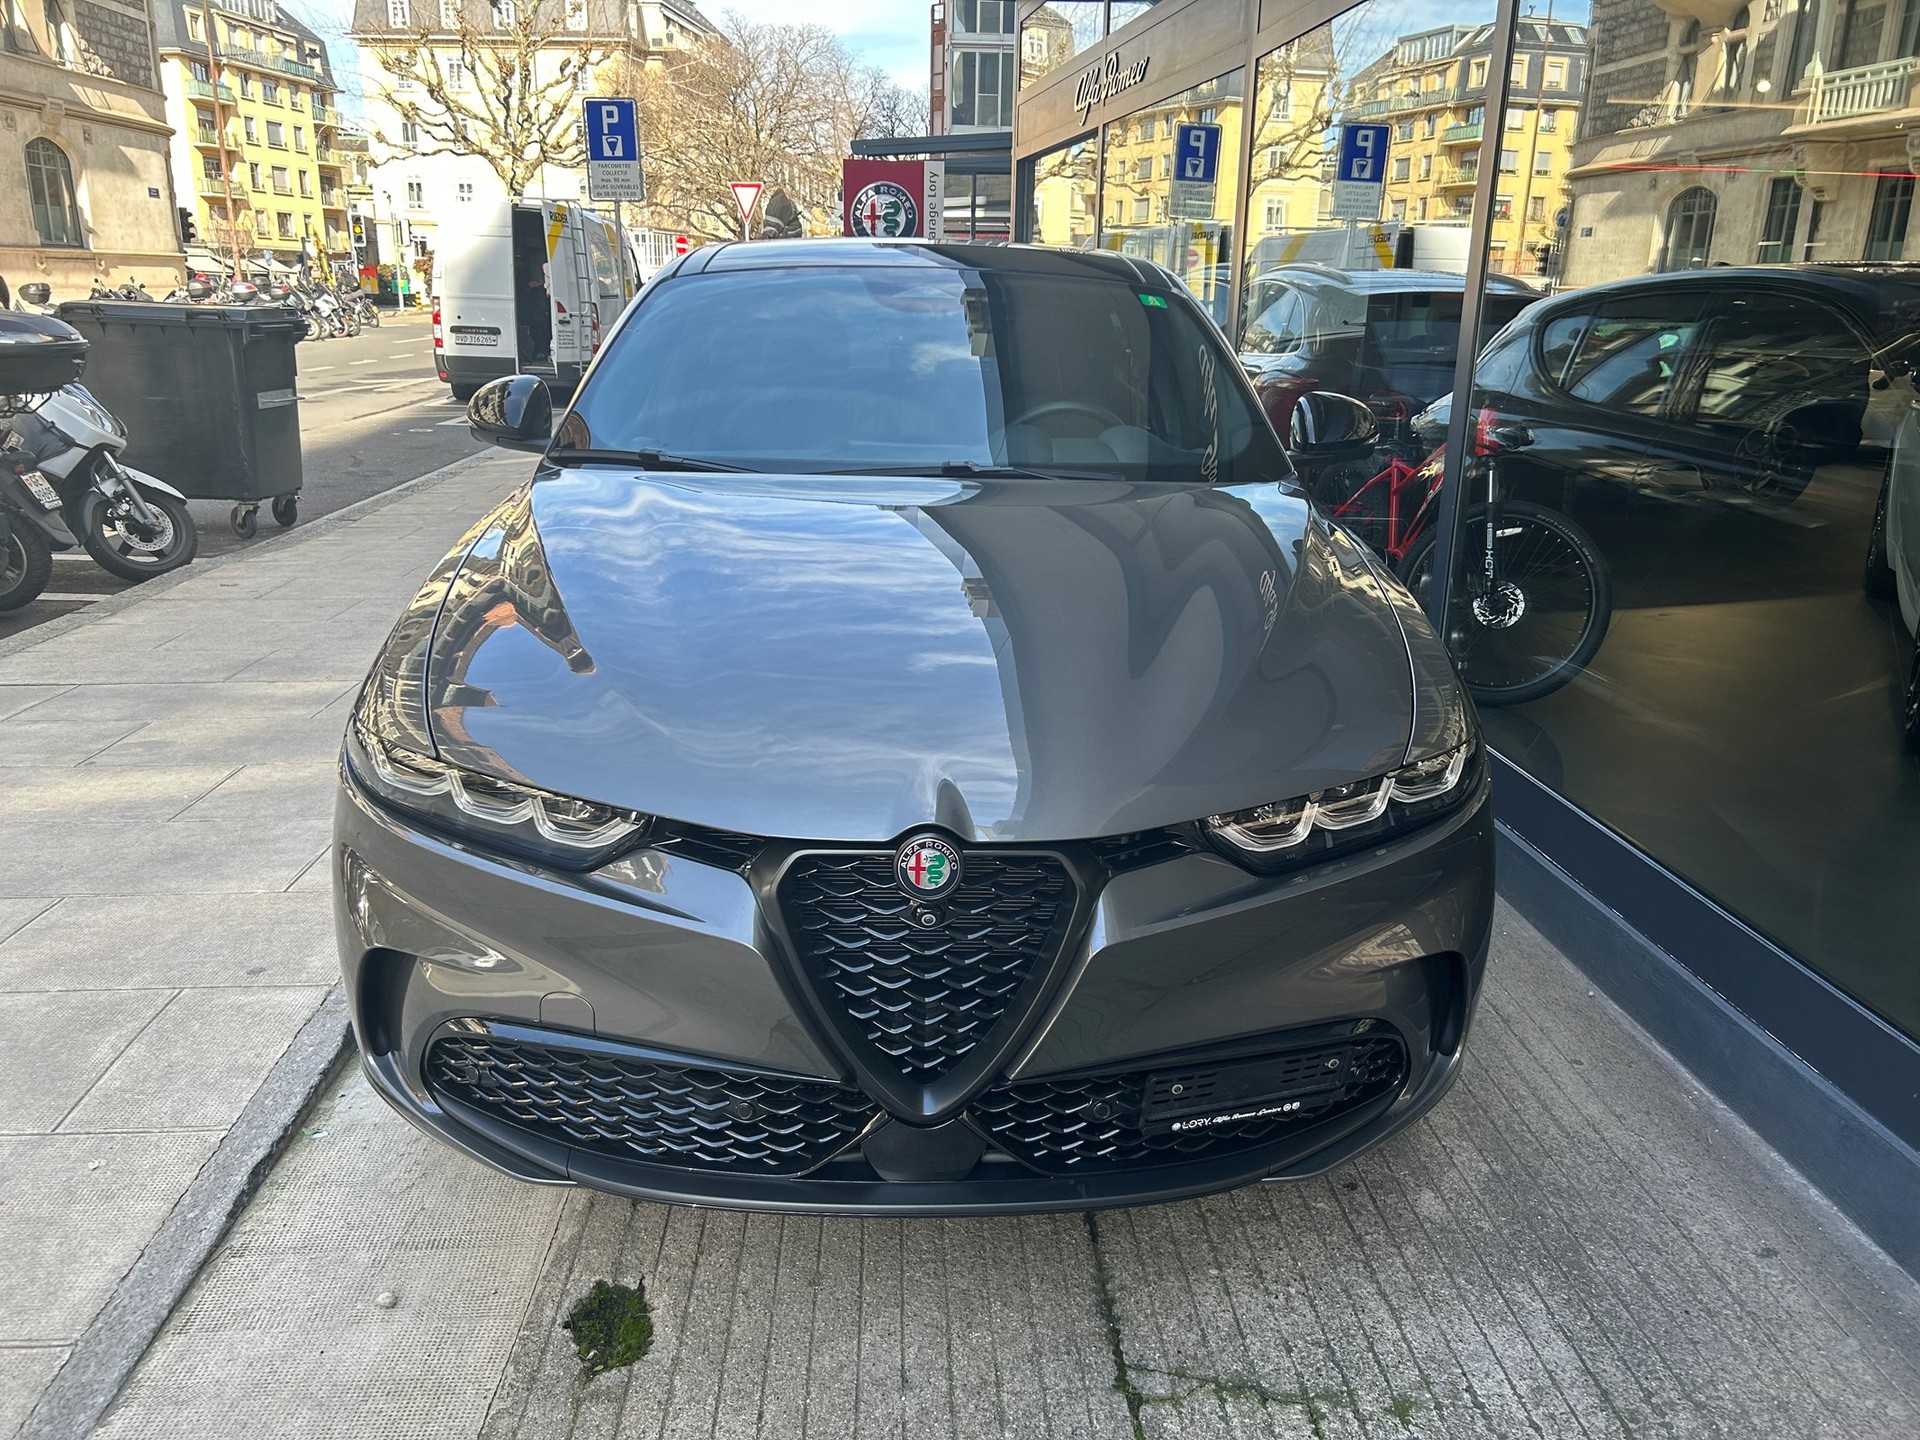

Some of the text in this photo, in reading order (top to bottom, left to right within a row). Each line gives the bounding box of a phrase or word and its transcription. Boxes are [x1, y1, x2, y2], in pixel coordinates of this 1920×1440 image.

[1074, 52, 1150, 127] Alfa Romeo
[601, 105, 619, 134] P
[927, 171, 939, 198] Lory
[854, 186, 914, 220] ALFA ROMEO
[928, 201, 939, 240] arage
[900, 841, 958, 870] ALFA ROMEO
